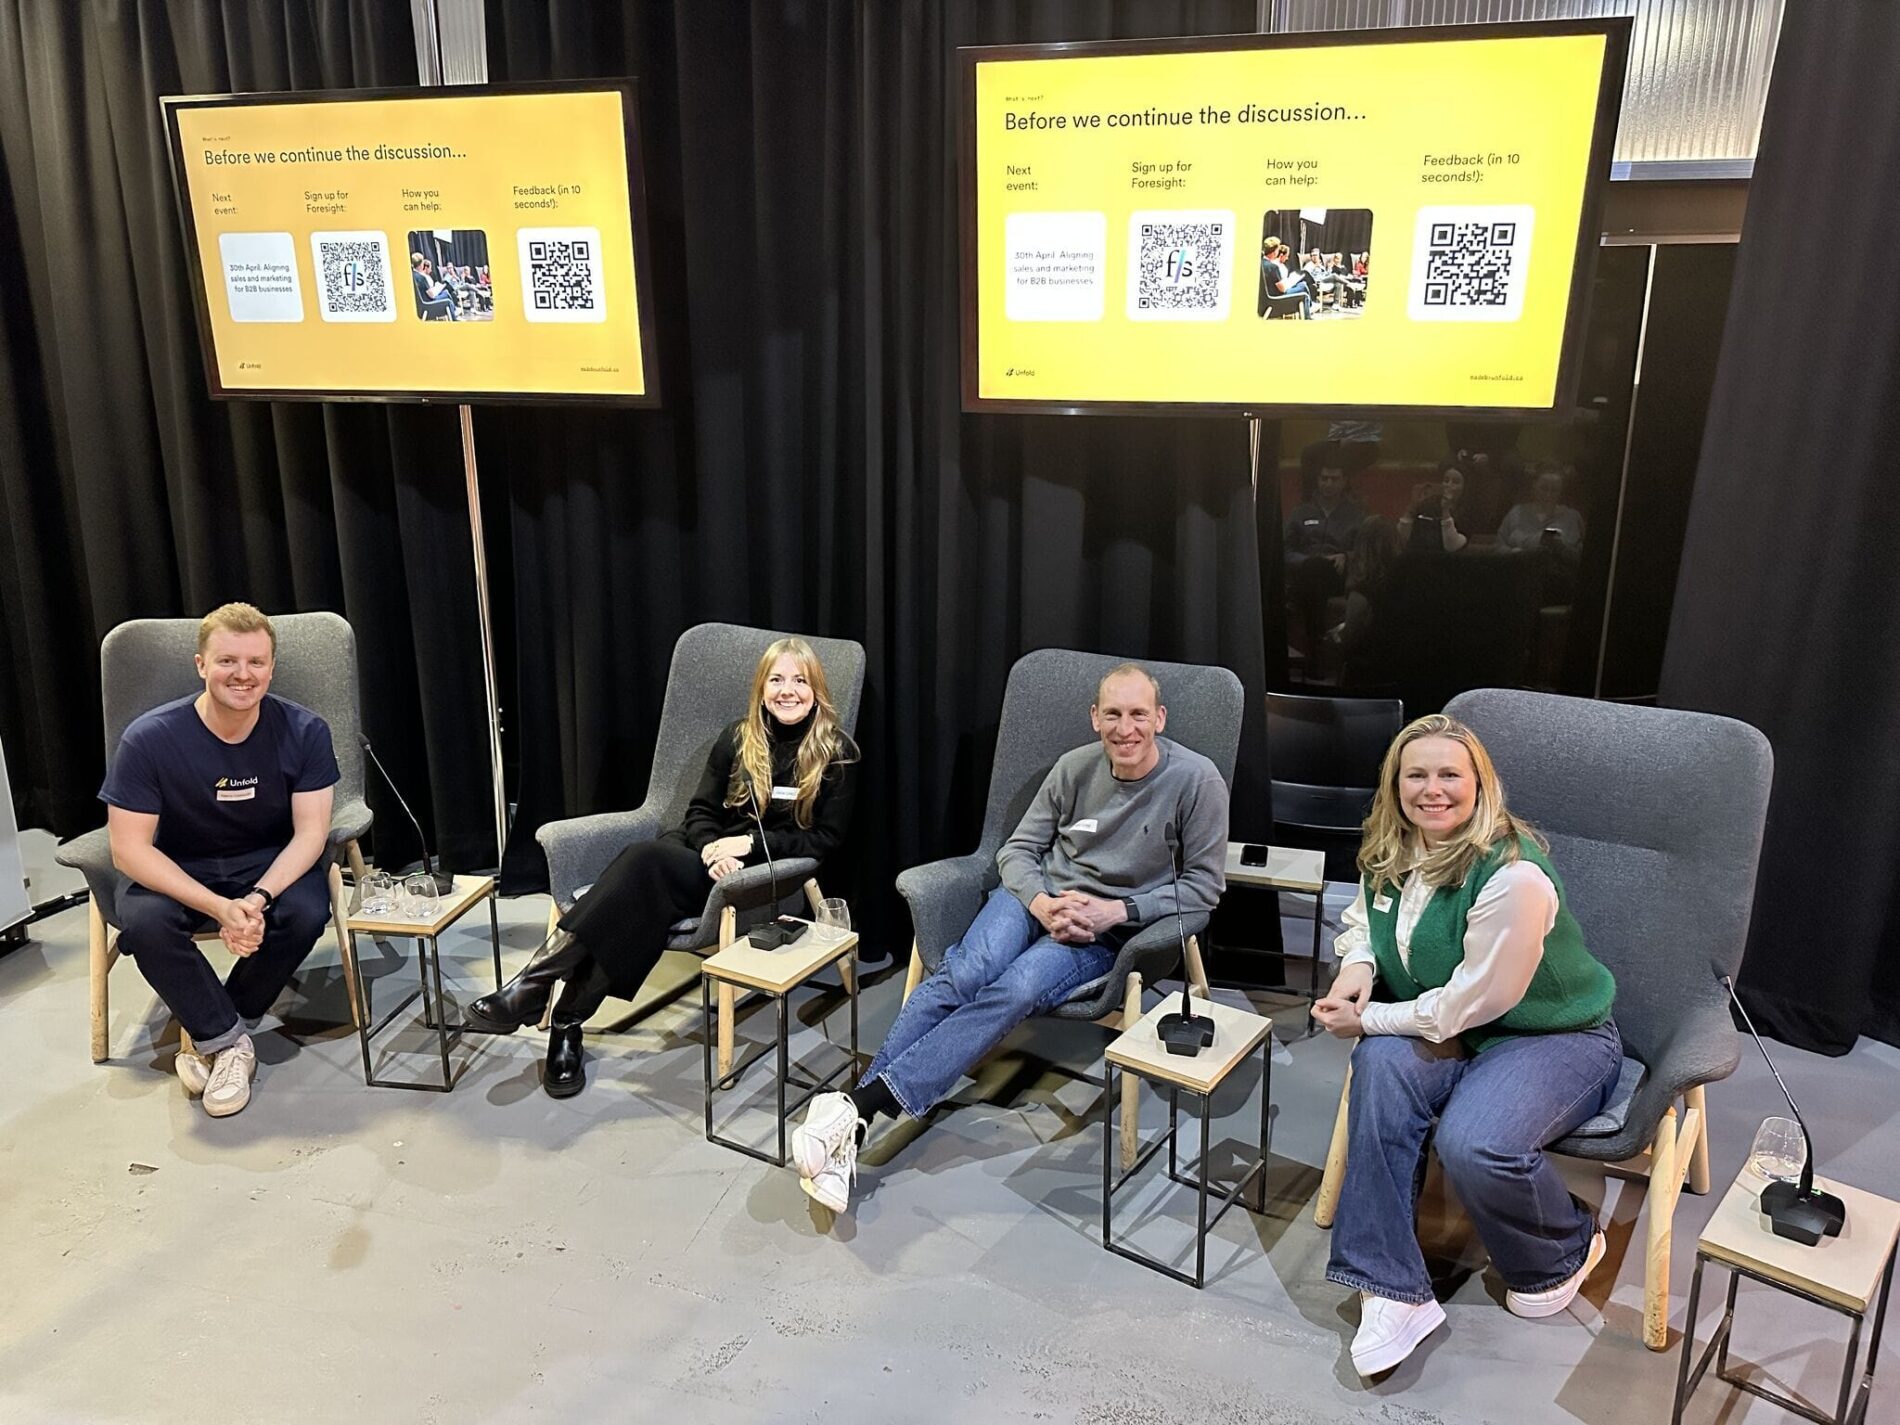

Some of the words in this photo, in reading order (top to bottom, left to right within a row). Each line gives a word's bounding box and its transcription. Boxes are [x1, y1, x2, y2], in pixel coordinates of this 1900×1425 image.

[1005, 111, 1067, 130] Before
[1072, 114, 1101, 128] we
[1106, 107, 1193, 127] continue
[1199, 105, 1231, 124] the
[204, 149, 251, 165] Before
[254, 152, 276, 164] we
[279, 146, 342, 163] continue
[345, 145, 370, 161] the
[1423, 154, 1484, 166] Feedback
[1487, 153, 1503, 166] (in
[1507, 153, 1520, 164] 10
[1006, 165, 1031, 175] Next
[1131, 161, 1156, 175] Sign
[1159, 163, 1173, 174] up
[1176, 160, 1192, 172] for
[1266, 158, 1294, 170] How
[1297, 160, 1318, 171] you
[1265, 176, 1286, 186] can
[1289, 174, 1318, 187] help:
[1421, 170, 1484, 183] seconds!):
[1006, 181, 1039, 191] event:
[1131, 177, 1186, 190] Foresight:
[402, 189, 422, 198] How
[423, 190, 439, 202] you
[513, 185, 556, 196] Feedback
[557, 184, 569, 195] (in
[571, 185, 581, 194] 10
[212, 193, 232, 202] Next
[304, 191, 323, 202] Sign
[324, 192, 335, 203] up
[337, 190, 348, 200] for
[403, 203, 419, 211] can
[420, 201, 442, 213] help:
[1014, 251, 1033, 260] 30th
[1059, 250, 1094, 261] Aligning
[229, 264, 244, 272] 30th
[263, 264, 290, 272] Aligning
[1013, 265, 1034, 273] sales
[1053, 265, 1095, 274] marketing
[260, 275, 292, 283] marketing
[1016, 277, 1028, 285] for
[1030, 277, 1046, 285] B2B
[1048, 277, 1094, 285] businesses
[229, 776, 259, 787] Unfold
